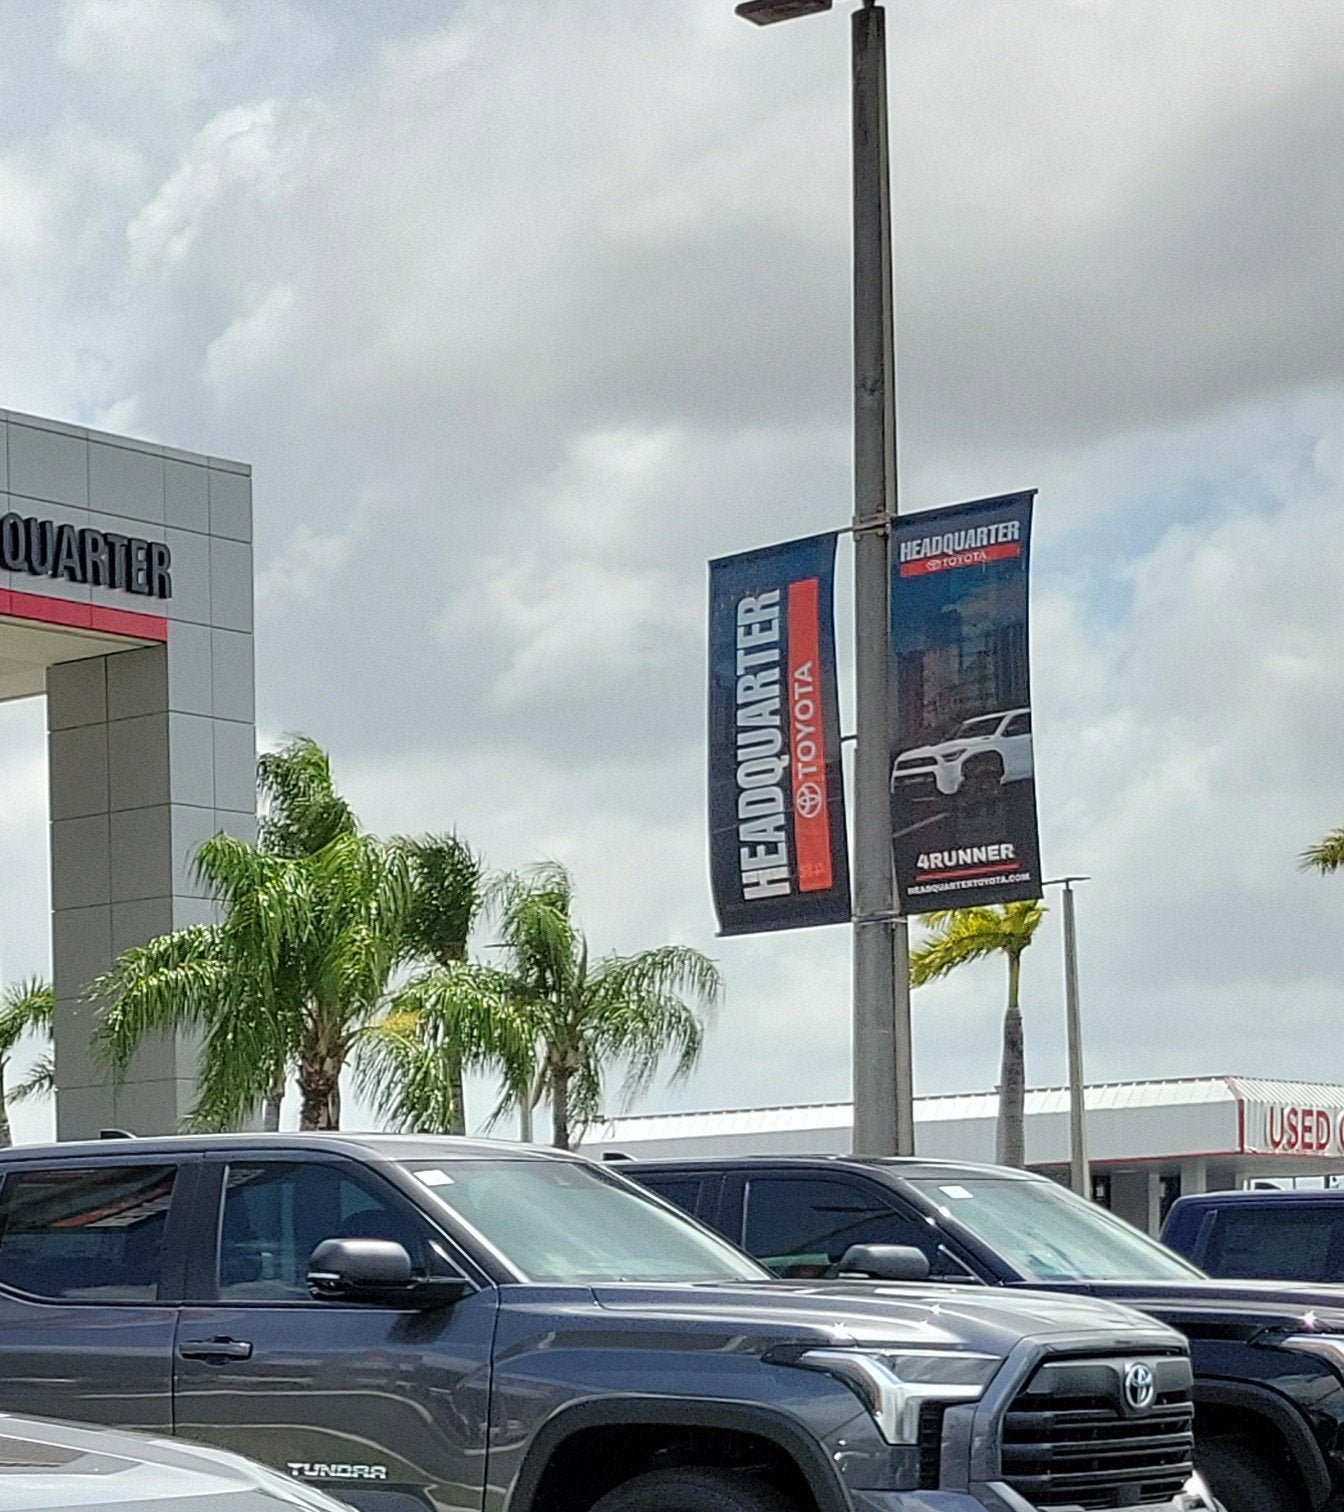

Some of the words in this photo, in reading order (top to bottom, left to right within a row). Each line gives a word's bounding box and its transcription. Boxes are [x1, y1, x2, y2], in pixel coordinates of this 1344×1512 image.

[900, 520, 1020, 563] HEADQUARTER
[941, 551, 987, 568] TOYOTA
[793, 661, 817, 780] TOYOTA
[736, 588, 791, 900] HEADQUARTER
[916, 843, 1015, 870] 4RUNNER
[1269, 1106, 1331, 1151] USED
[287, 1462, 387, 1479] TUNDRA
